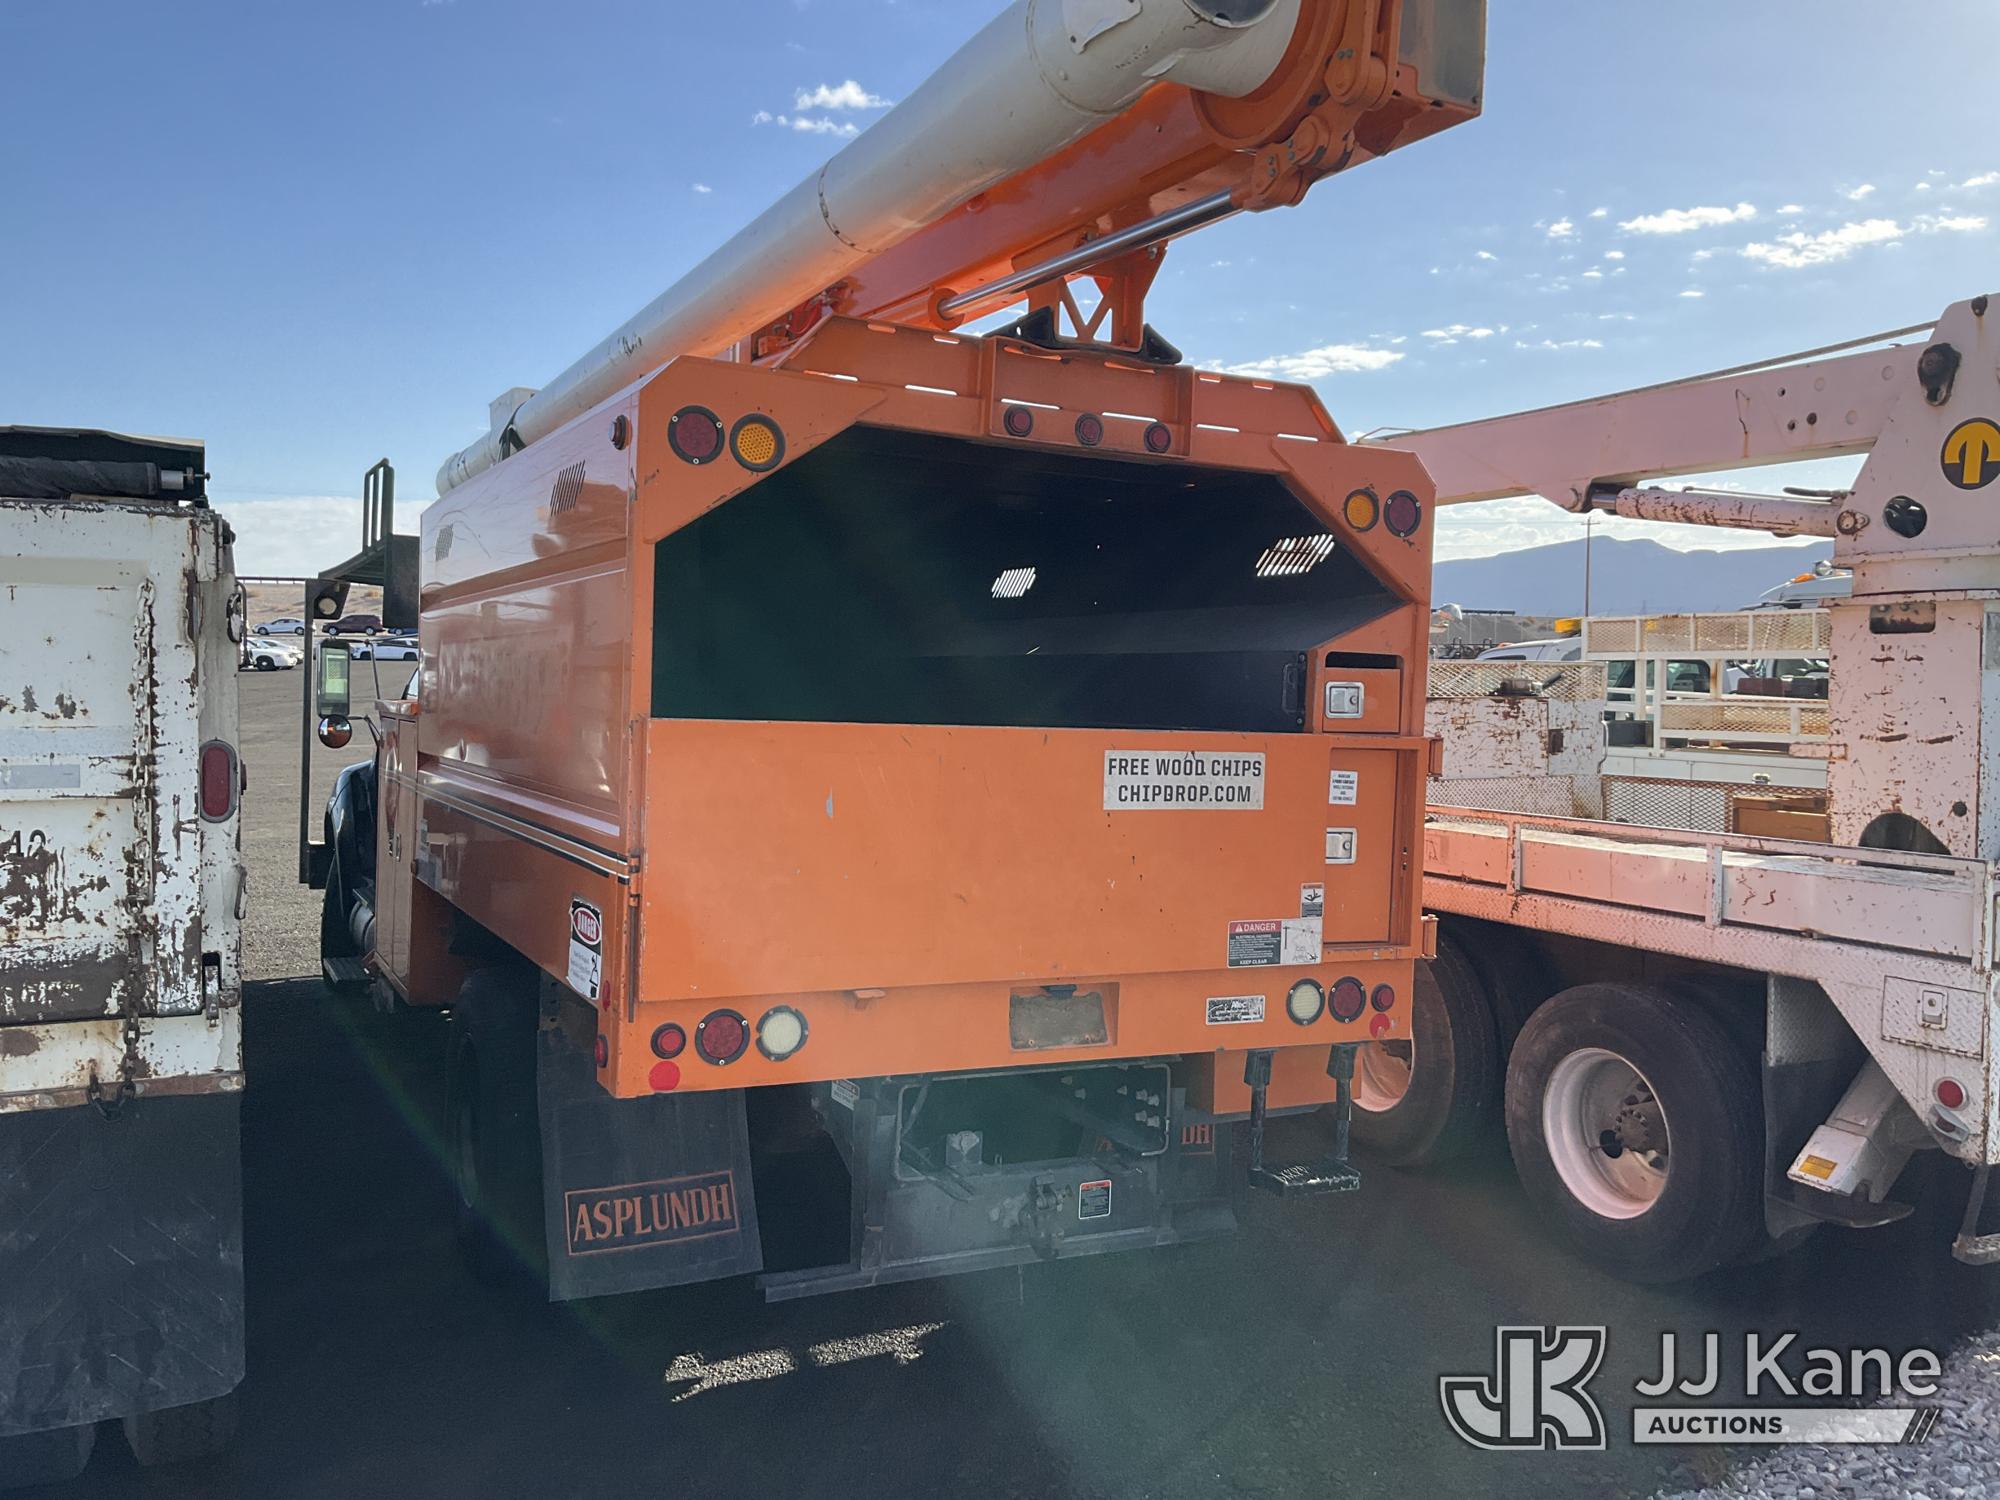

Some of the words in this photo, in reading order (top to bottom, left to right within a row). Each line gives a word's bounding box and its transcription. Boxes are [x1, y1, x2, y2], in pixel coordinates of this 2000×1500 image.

[1108, 758, 1149, 776] FREE
[1156, 758, 1206, 777] WOOD
[1211, 759, 1262, 777] CHIPS
[1118, 784, 1251, 803] CHIPDROP.COM
[1243, 922, 1276, 932] DANGER
[573, 1183, 733, 1242] ASPLUNDH
